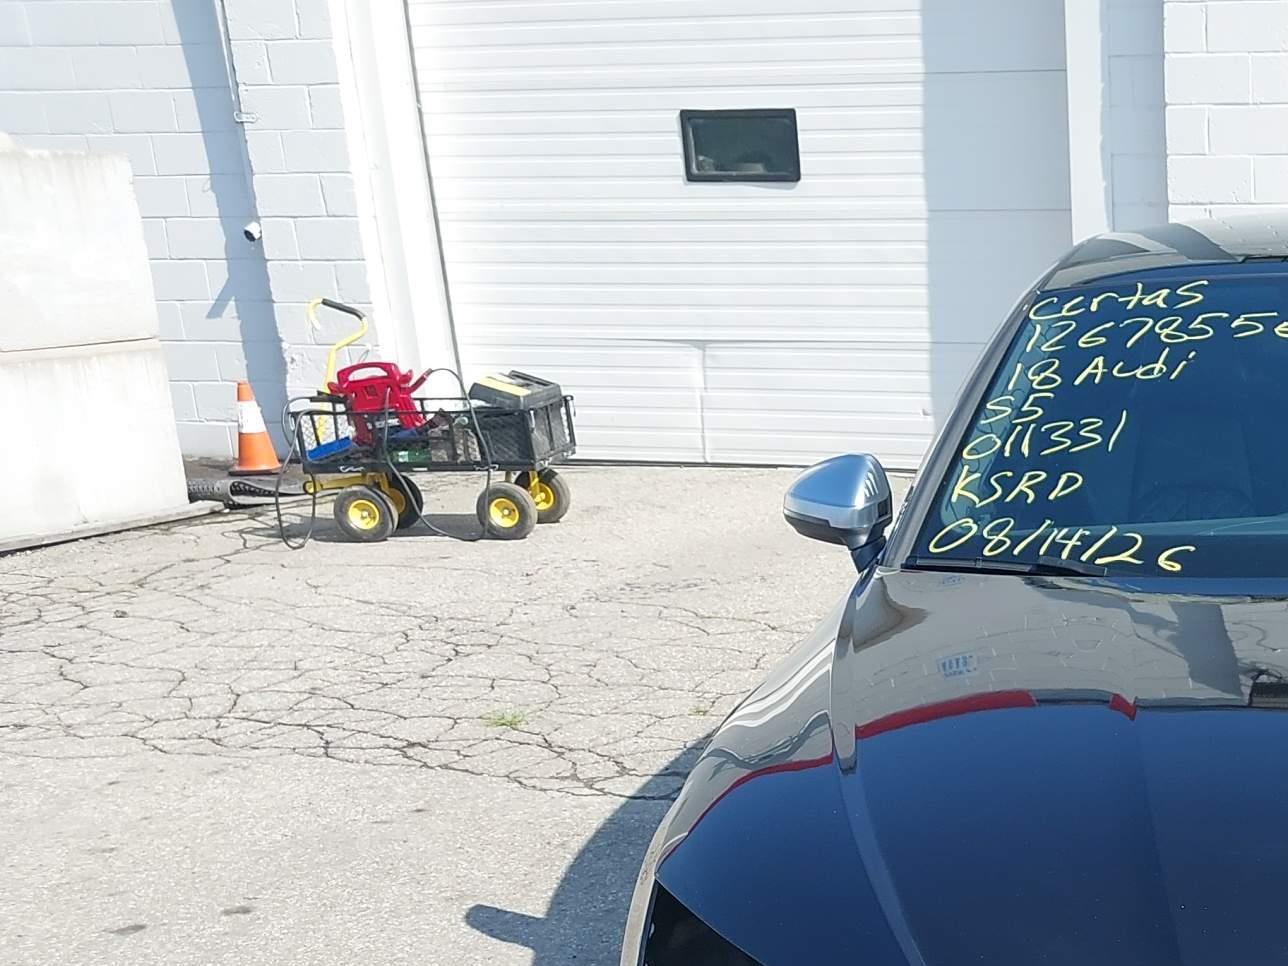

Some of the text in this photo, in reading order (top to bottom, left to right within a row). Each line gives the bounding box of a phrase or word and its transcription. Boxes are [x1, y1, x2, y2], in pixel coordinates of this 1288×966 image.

[1008, 347, 1196, 391] 18 Audi
[980, 392, 1054, 425] S5
[962, 409, 1127, 460] 011331
